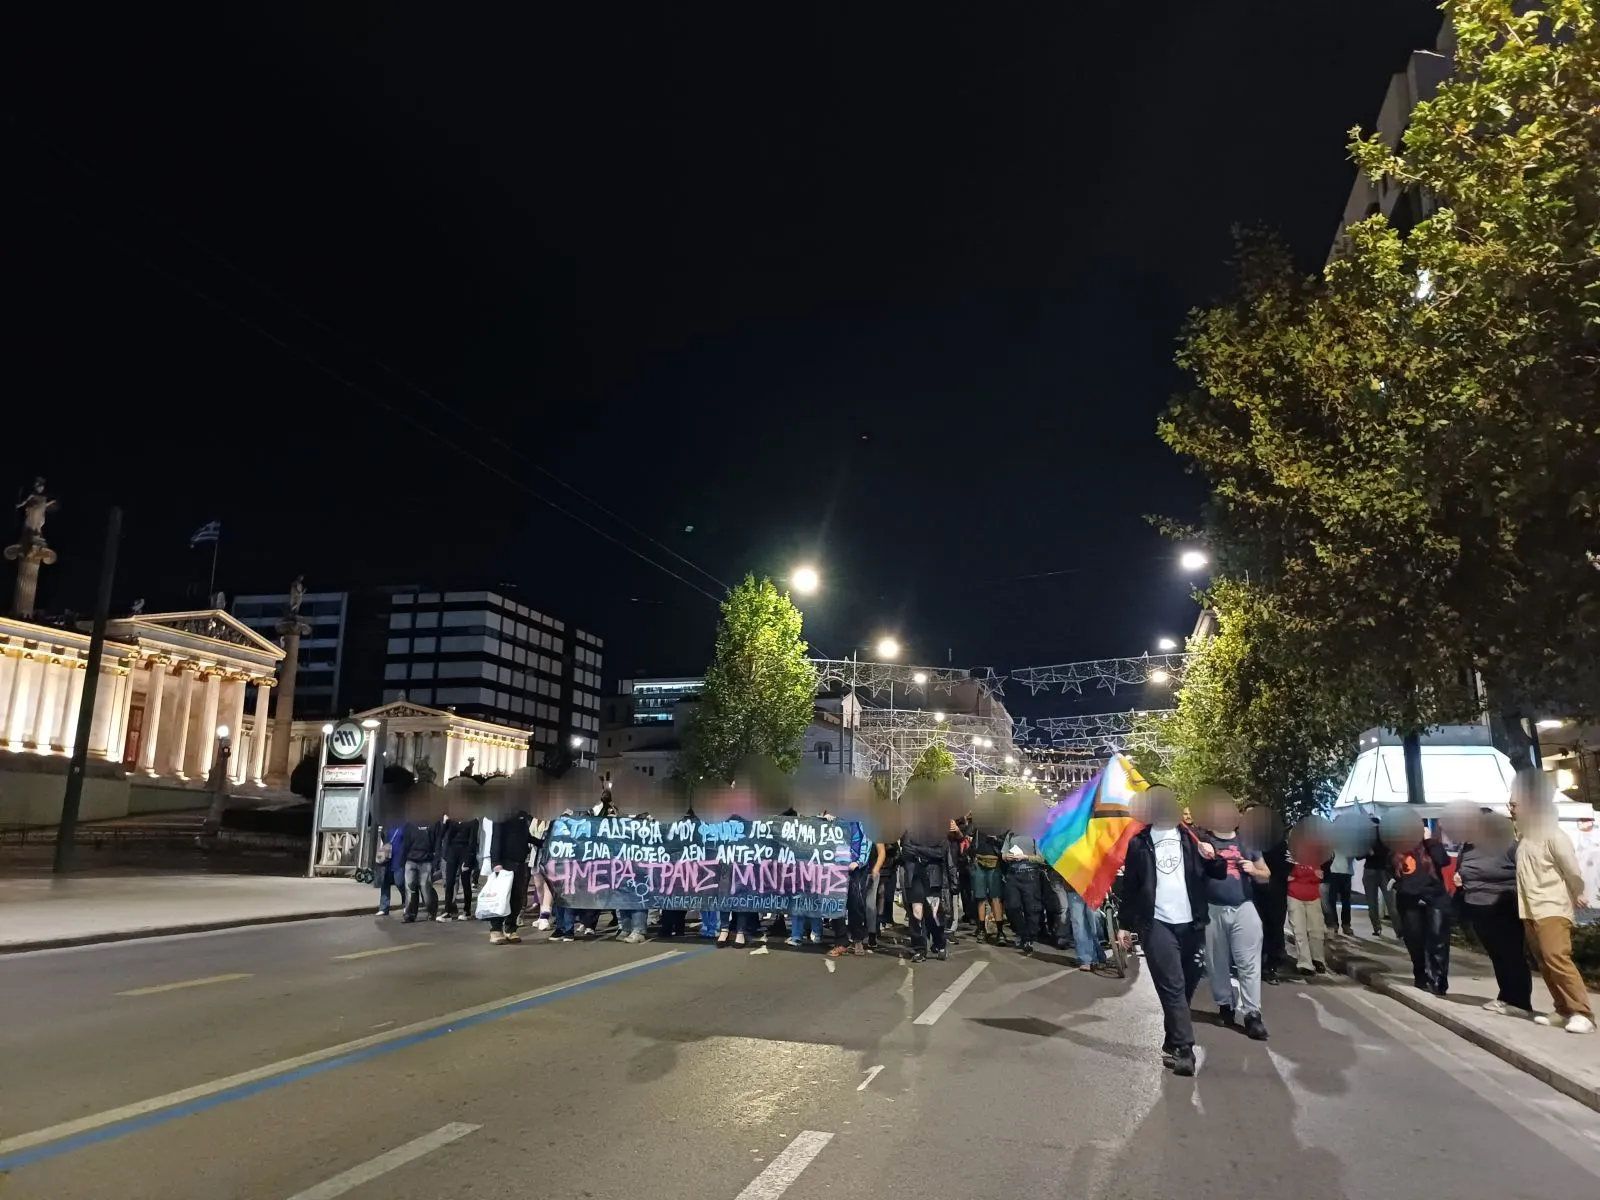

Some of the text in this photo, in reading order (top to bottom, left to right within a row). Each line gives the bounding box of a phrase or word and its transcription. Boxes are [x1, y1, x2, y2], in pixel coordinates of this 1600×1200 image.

[597, 817, 663, 845] ΑΔΕΡΦΙΑ
[667, 819, 696, 842] ΜΟΥ
[581, 840, 611, 862] ΕΝΑ
[615, 843, 671, 864] ΛΙΓΟΤΕΡΟ
[680, 844, 706, 863] ΔΕΝ
[777, 846, 797, 865] ΝΑ
[1157, 853, 1178, 869] kids
[546, 858, 850, 895] ΗΜΕΡΑ ΤΡΑΝΣ ΜΝΗΜΗΣ
